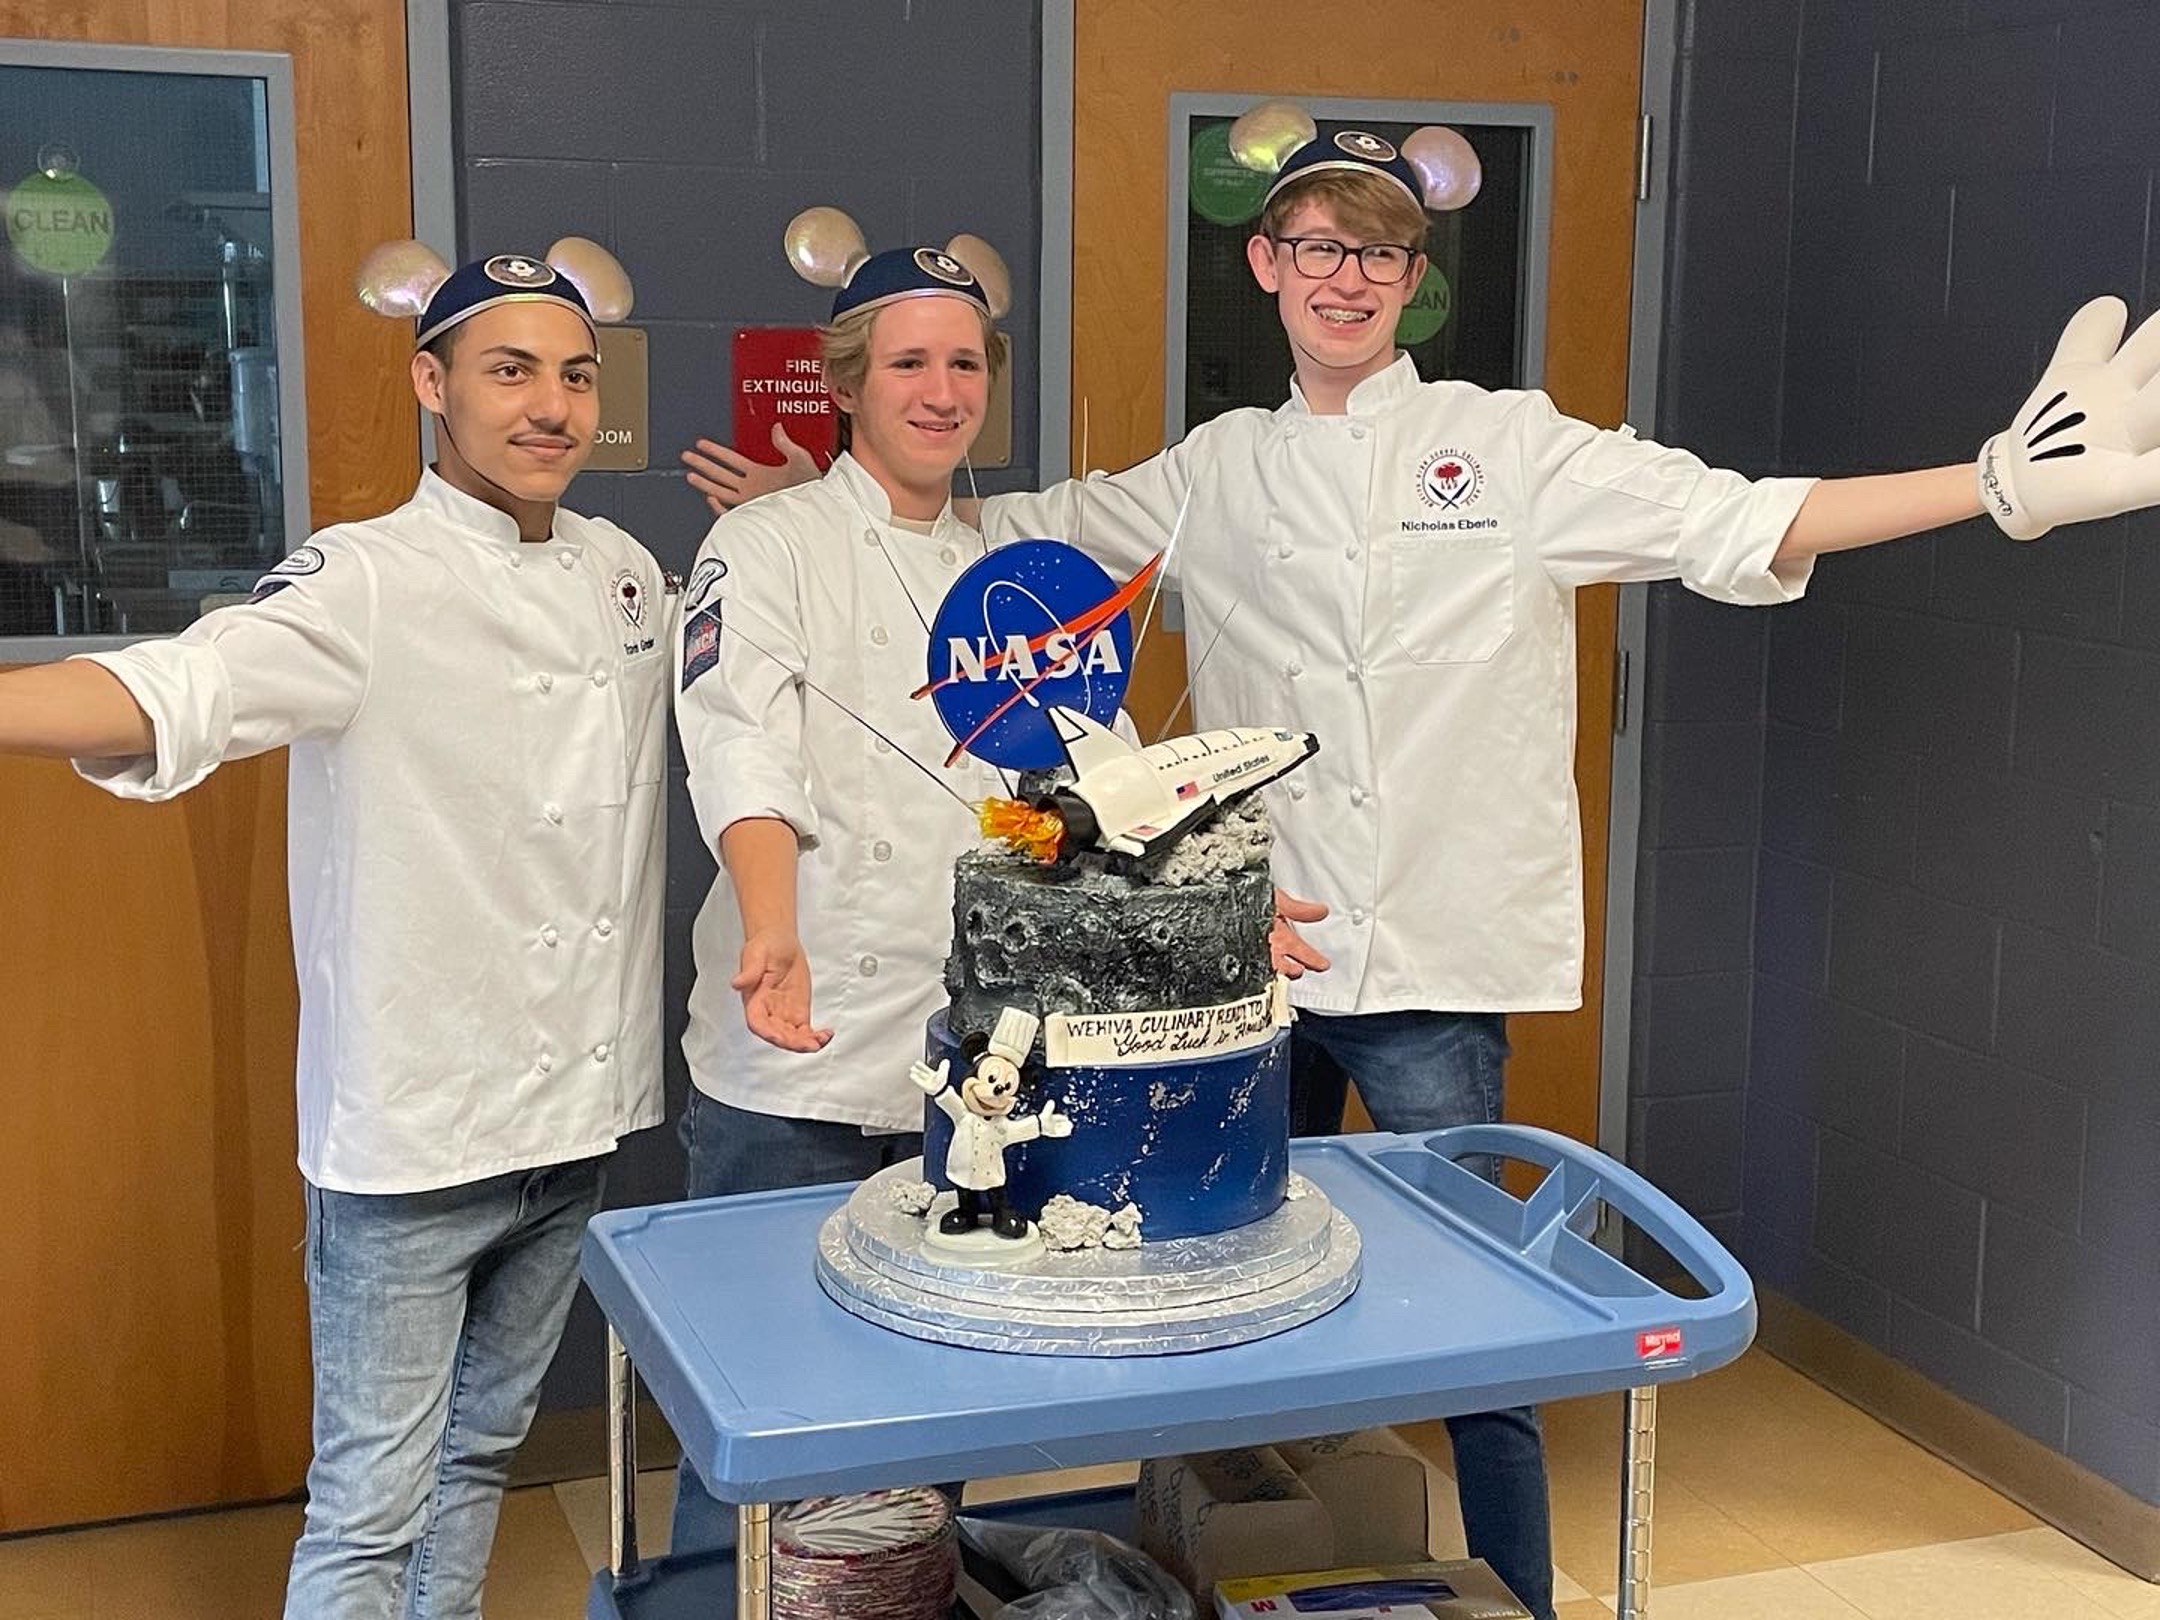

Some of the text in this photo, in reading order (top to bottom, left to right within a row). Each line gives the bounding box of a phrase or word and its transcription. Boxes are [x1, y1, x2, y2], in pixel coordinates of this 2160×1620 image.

[14, 209, 109, 234] CLEAN
[785, 359, 821, 373] FIRE
[742, 379, 829, 394] EXTINGUIS
[776, 400, 831, 414] INSIDE
[593, 430, 633, 444] OOM
[1401, 520, 1456, 532] Nicholas
[947, 629, 1123, 683] NASA
[1212, 755, 1271, 783] United States
[1139, 1008, 1216, 1034] CULINARY
[1247, 1000, 1263, 1018] TO
[1112, 1031, 1167, 1057] Good
[1170, 1027, 1211, 1051] Luck
